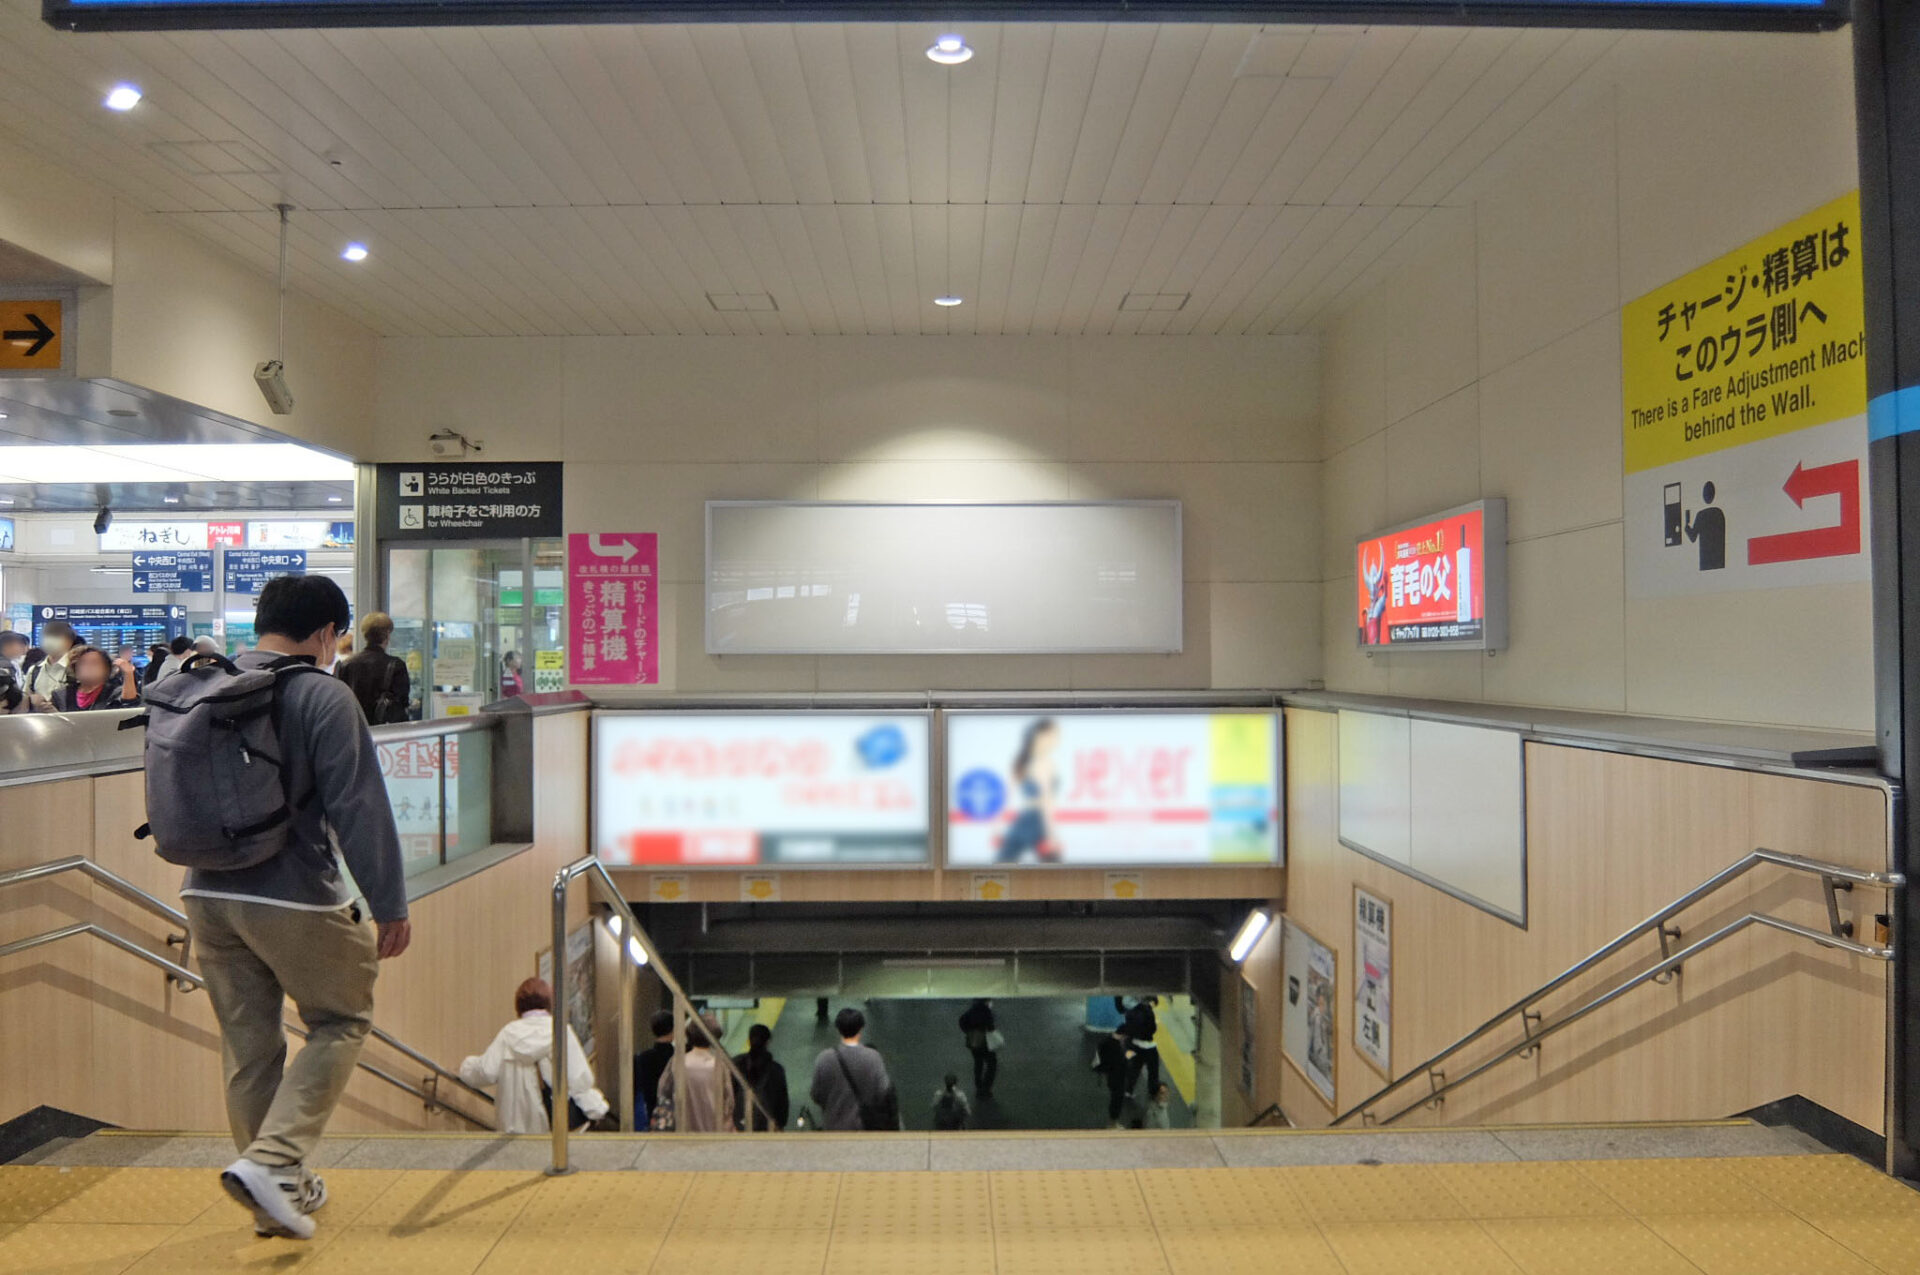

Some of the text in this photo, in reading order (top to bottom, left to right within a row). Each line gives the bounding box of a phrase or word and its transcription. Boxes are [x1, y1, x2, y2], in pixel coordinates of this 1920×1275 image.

[1658, 221, 1850, 343] チャージ・精算は
[1675, 298, 1828, 382] このウラ側へ
[1631, 405, 1665, 430] There
[1667, 397, 1678, 419] is
[1681, 396, 1689, 414] a
[1692, 386, 1722, 410] Fare
[1726, 349, 1816, 399] Adjustment
[1684, 384, 1816, 442] behind the Wall.
[428, 472, 536, 485] うらが白色のきっぷ
[428, 487, 511, 495] White Backed Tickets
[138, 525, 190, 546] ねぎし
[427, 504, 542, 518] 車椅子をご利用の方
[427, 520, 484, 528] for Wheelchair
[1390, 554, 1451, 608] 育毛の父
[582, 580, 597, 671] きっぷのご精算
[600, 580, 628, 662] 精算機
[633, 580, 647, 685] ICカードのチャージ
